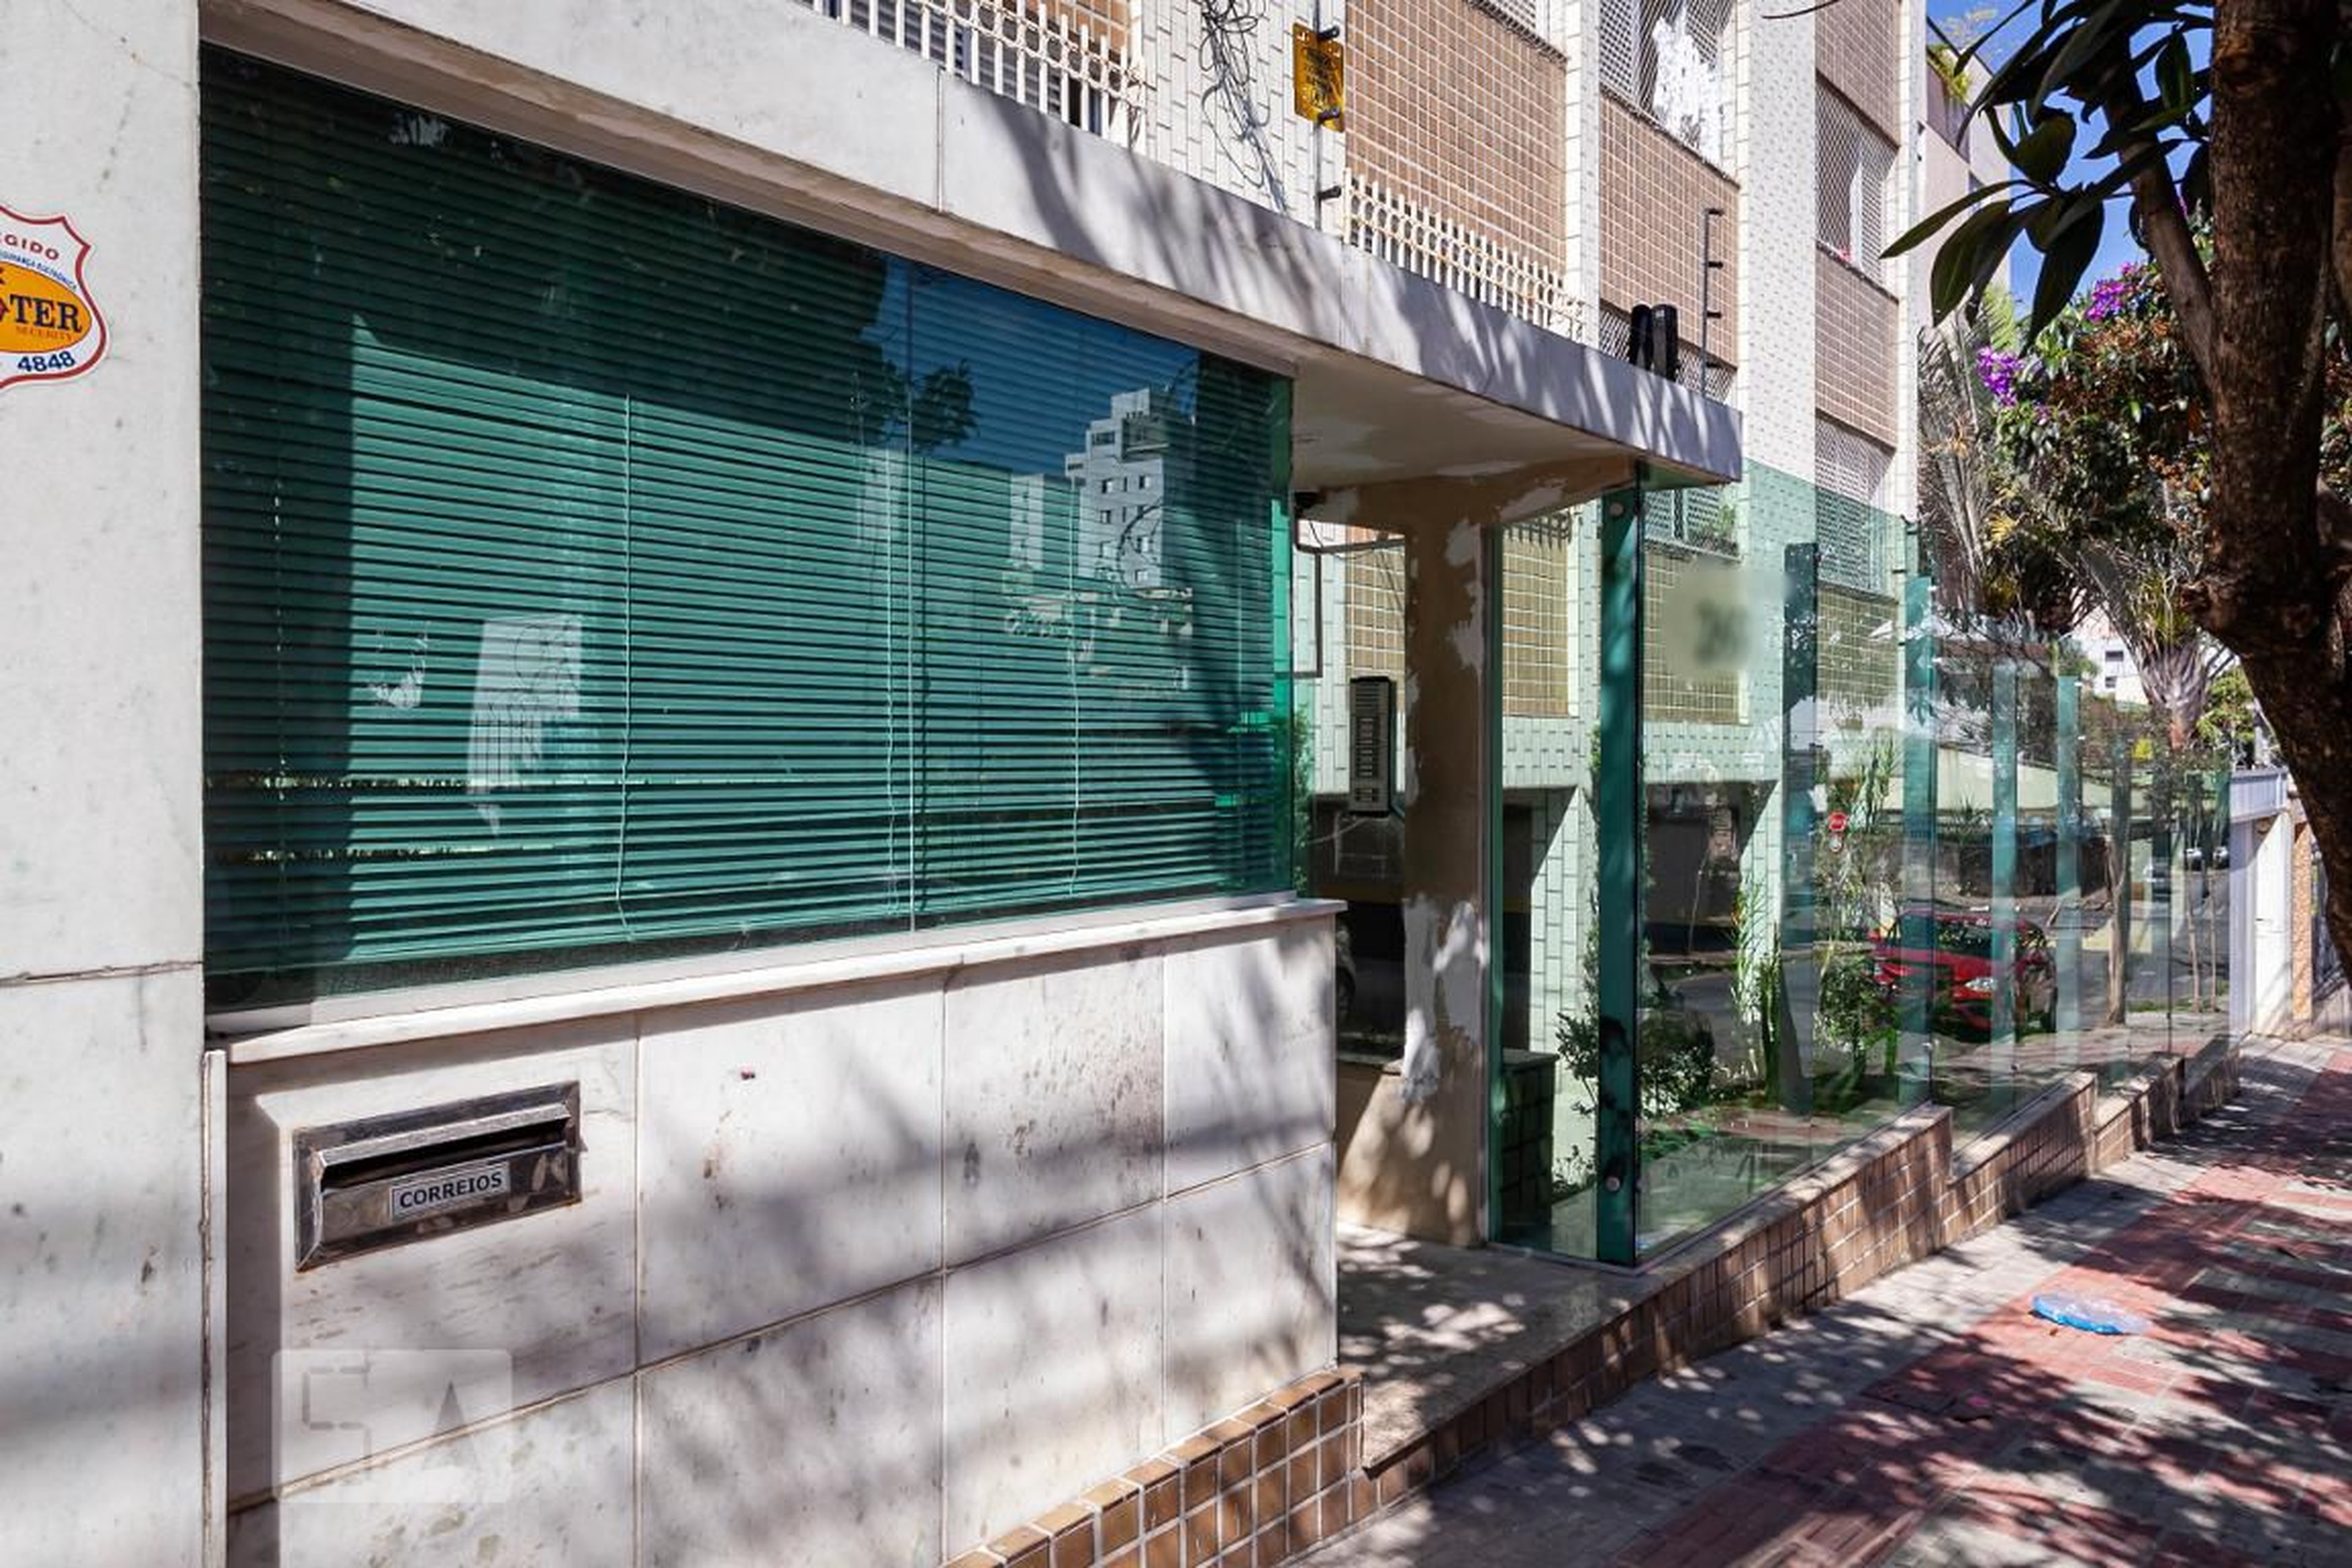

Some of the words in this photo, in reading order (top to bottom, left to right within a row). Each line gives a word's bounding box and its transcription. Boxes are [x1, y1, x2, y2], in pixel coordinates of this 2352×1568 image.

[0, 234, 59, 260] GIDO
[18, 351, 75, 372] 4848
[399, 1172, 502, 1209] CORREIOS
